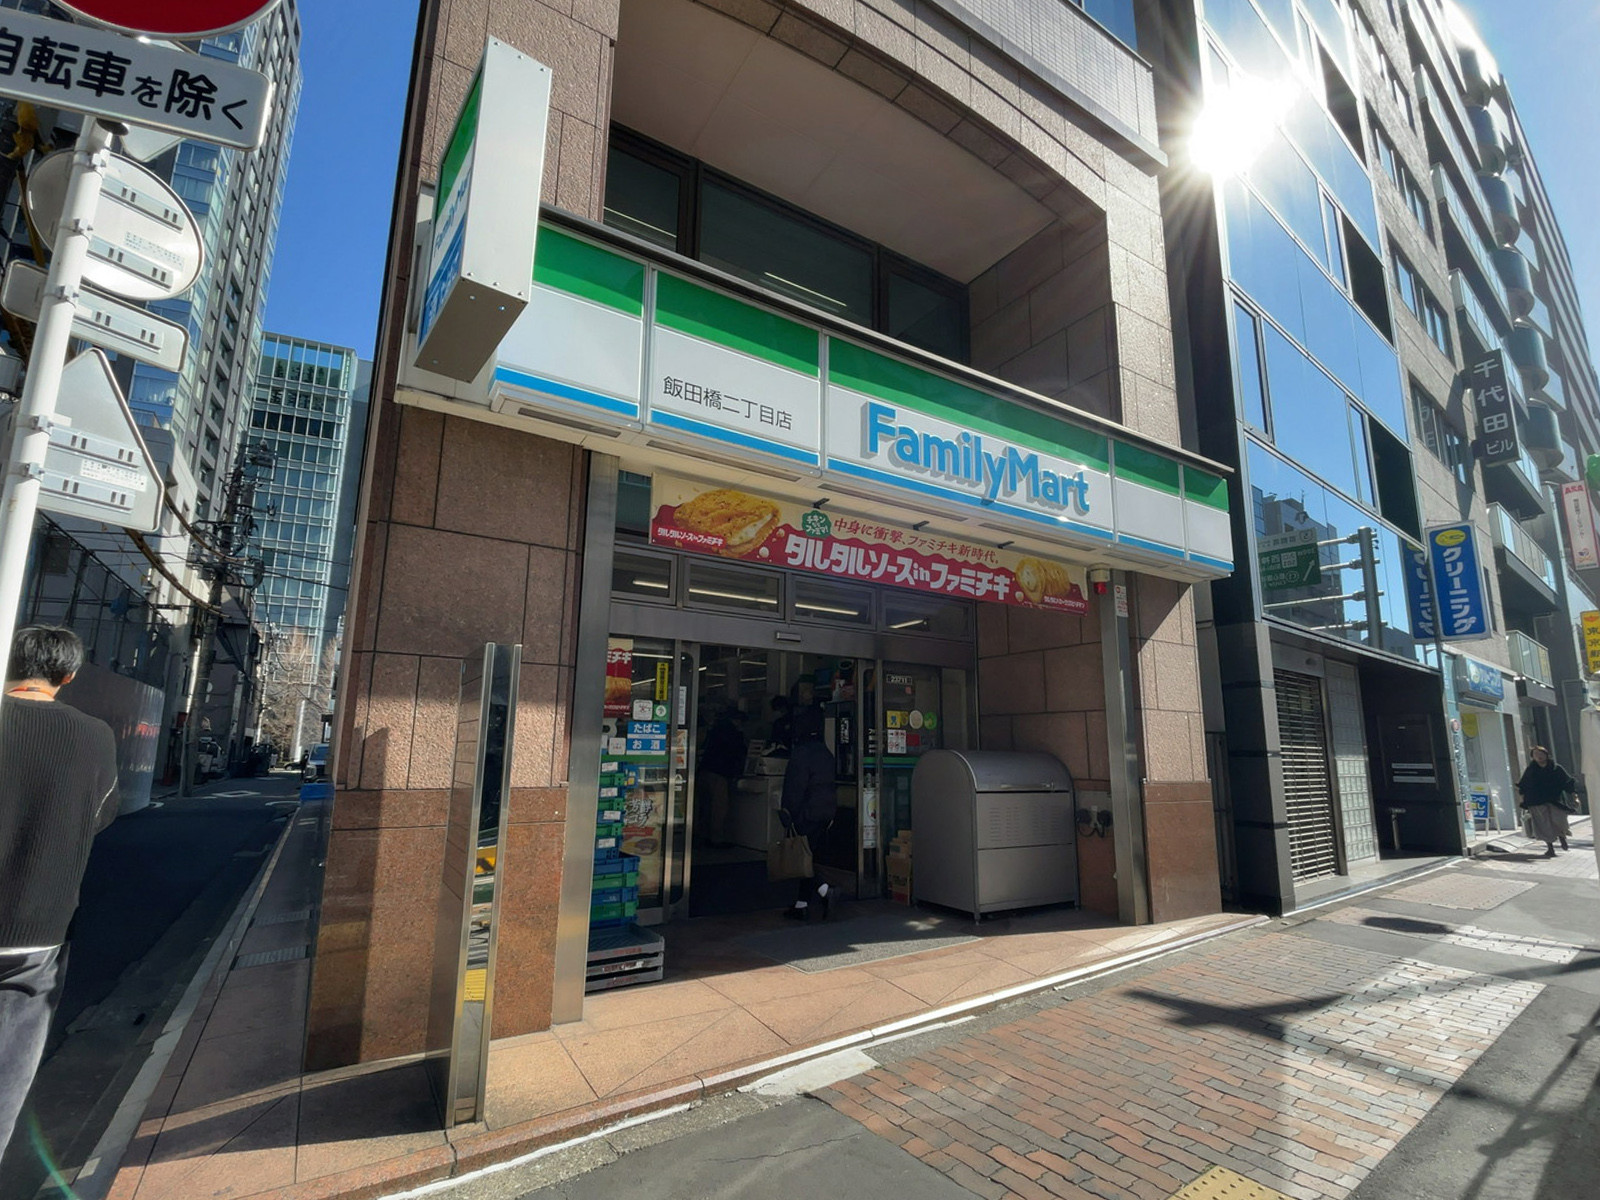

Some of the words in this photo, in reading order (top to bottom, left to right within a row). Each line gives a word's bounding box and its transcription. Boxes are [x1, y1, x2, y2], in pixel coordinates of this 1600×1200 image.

[663, 376, 792, 430] 飯田橋二丁目店
[1473, 358, 1514, 455] 千代田ビル
[863, 401, 1090, 513] FamilyMart
[785, 535, 1010, 600] タルタルソースinファミチキ
[834, 518, 999, 564] 中身に衝撃、ファミチキ新時代。
[1443, 547, 1476, 634] クリーニング
[633, 723, 661, 733] たばこ
